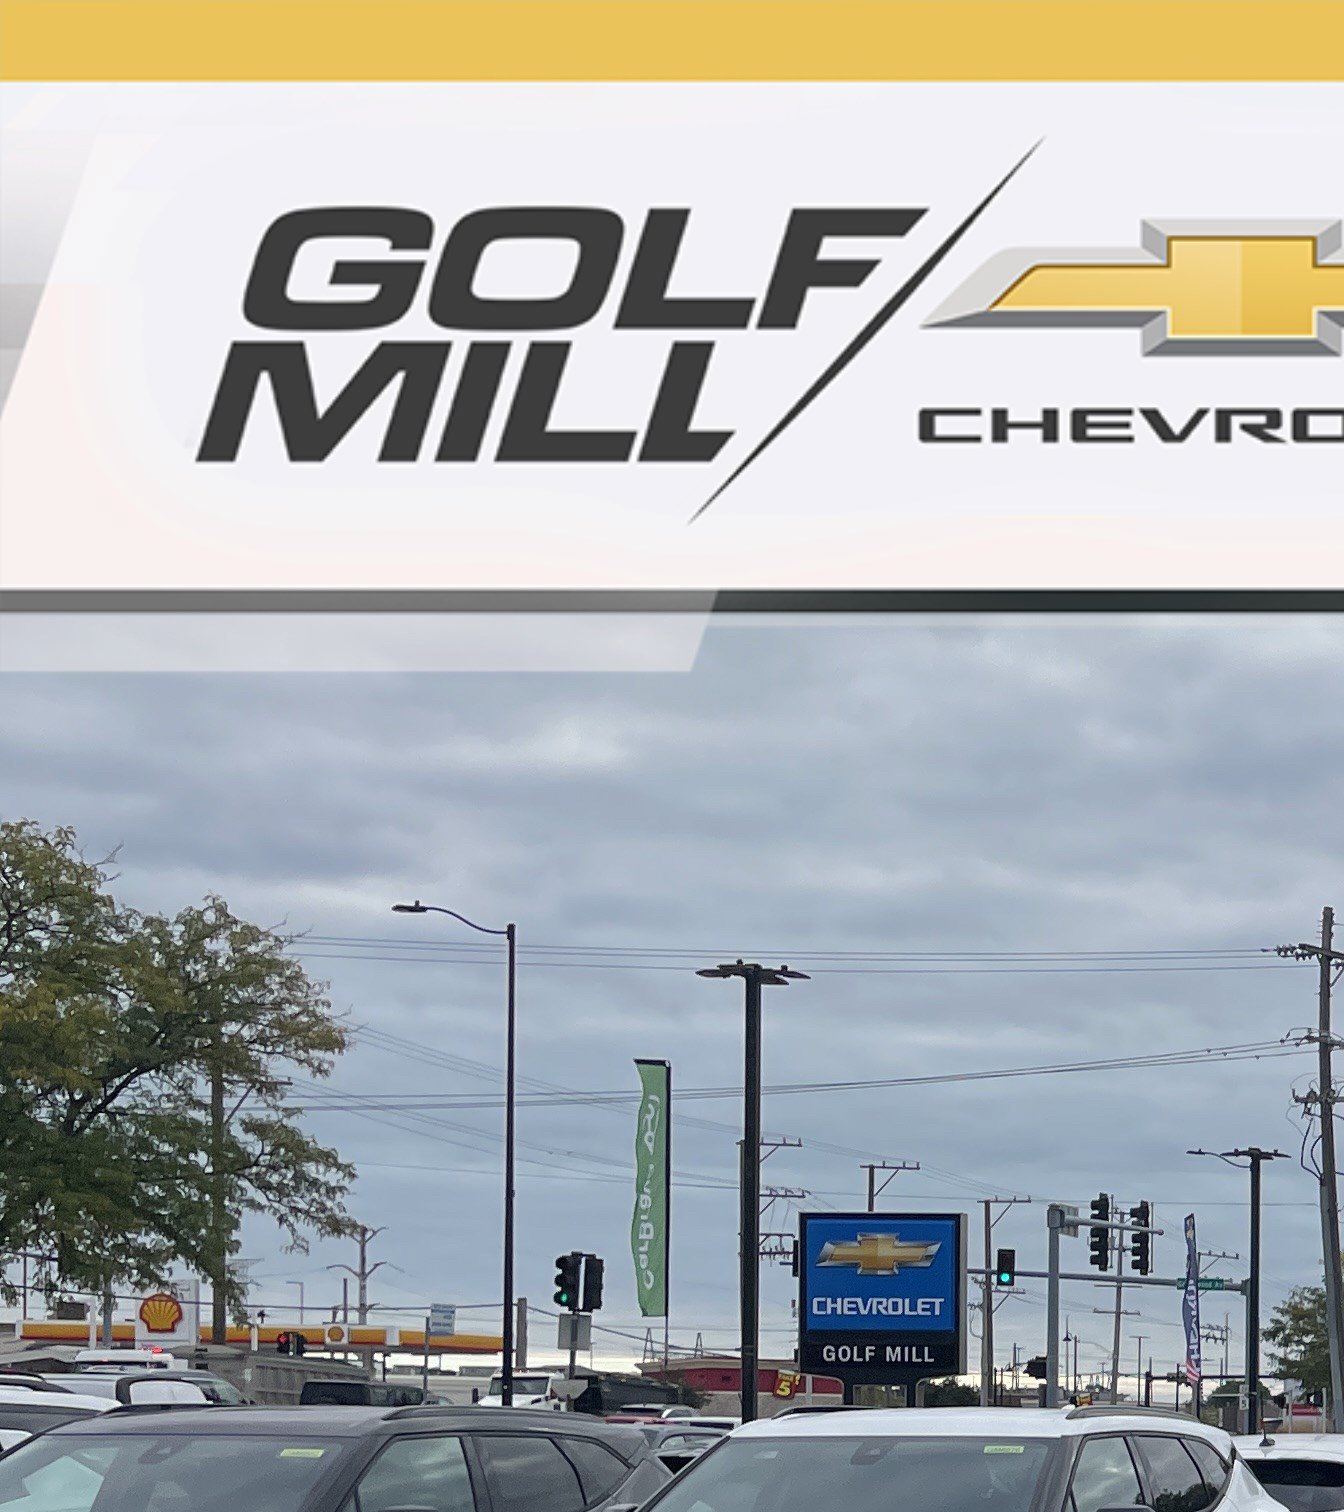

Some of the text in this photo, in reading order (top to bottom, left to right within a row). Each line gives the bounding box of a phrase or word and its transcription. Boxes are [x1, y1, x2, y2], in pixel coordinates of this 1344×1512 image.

[812, 1296, 945, 1316] CHEVROLET
[822, 1344, 935, 1363] GOLF MILL
[776, 1380, 791, 1397] 5
